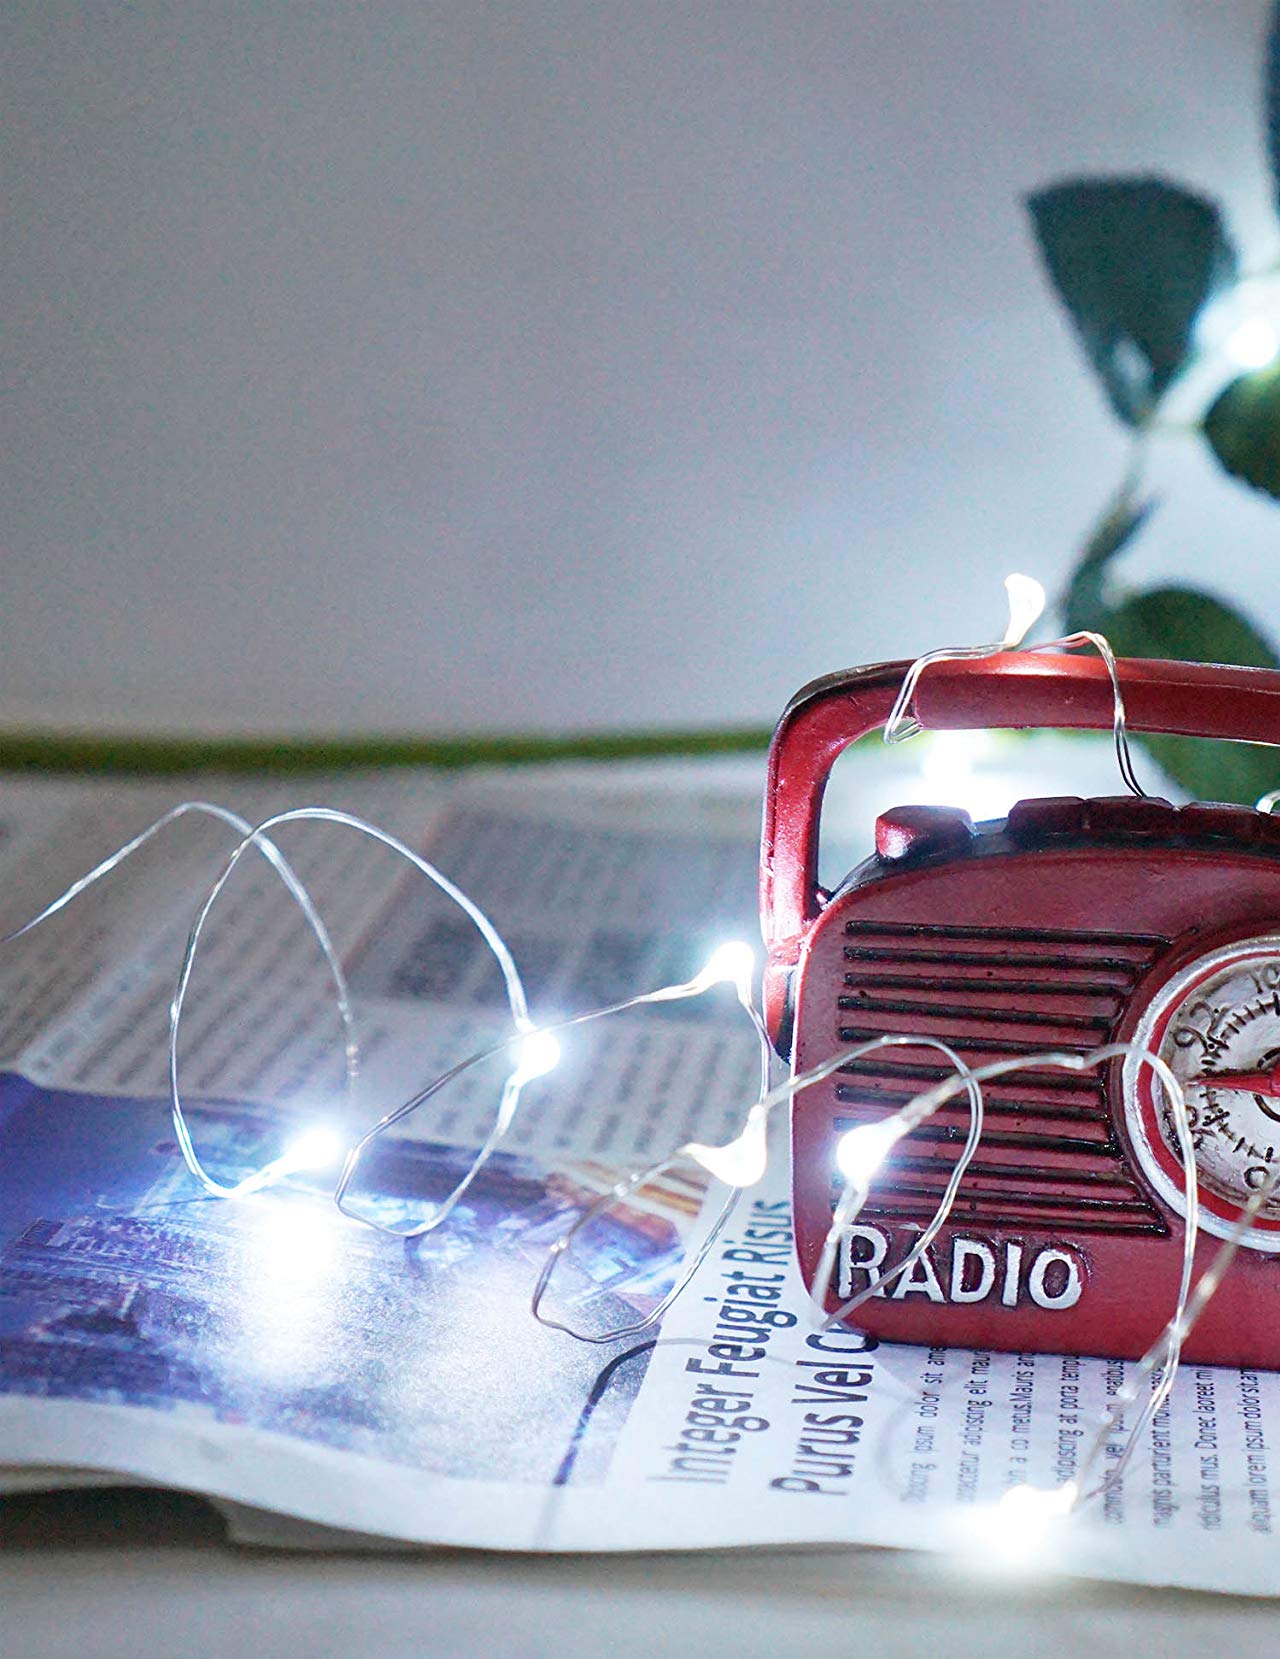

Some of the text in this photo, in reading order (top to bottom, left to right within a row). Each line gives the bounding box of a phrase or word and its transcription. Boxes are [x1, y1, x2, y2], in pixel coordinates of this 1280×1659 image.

[838, 1224, 1082, 1310] RADIO
[646, 1200, 797, 1485] Integer Feugiat Risus
[791, 1360, 875, 1404] Vel
[921, 1372, 943, 1385] sit
[965, 1380, 989, 1395] elit
[916, 1392, 940, 1418] dolor
[1059, 1385, 1085, 1410] porta
[1194, 1382, 1216, 1414] laoreet
[1239, 1394, 1262, 1419] dolor
[960, 1400, 993, 1446] adipiscing
[1060, 1414, 1079, 1425] at
[1196, 1417, 1219, 1450] Donec
[1242, 1421, 1271, 1452] ipsum
[769, 1413, 864, 1495] Purus
[1149, 1430, 1179, 1486] parturient
[1201, 1454, 1220, 1479] mus.
[1245, 1454, 1268, 1486] lorem
